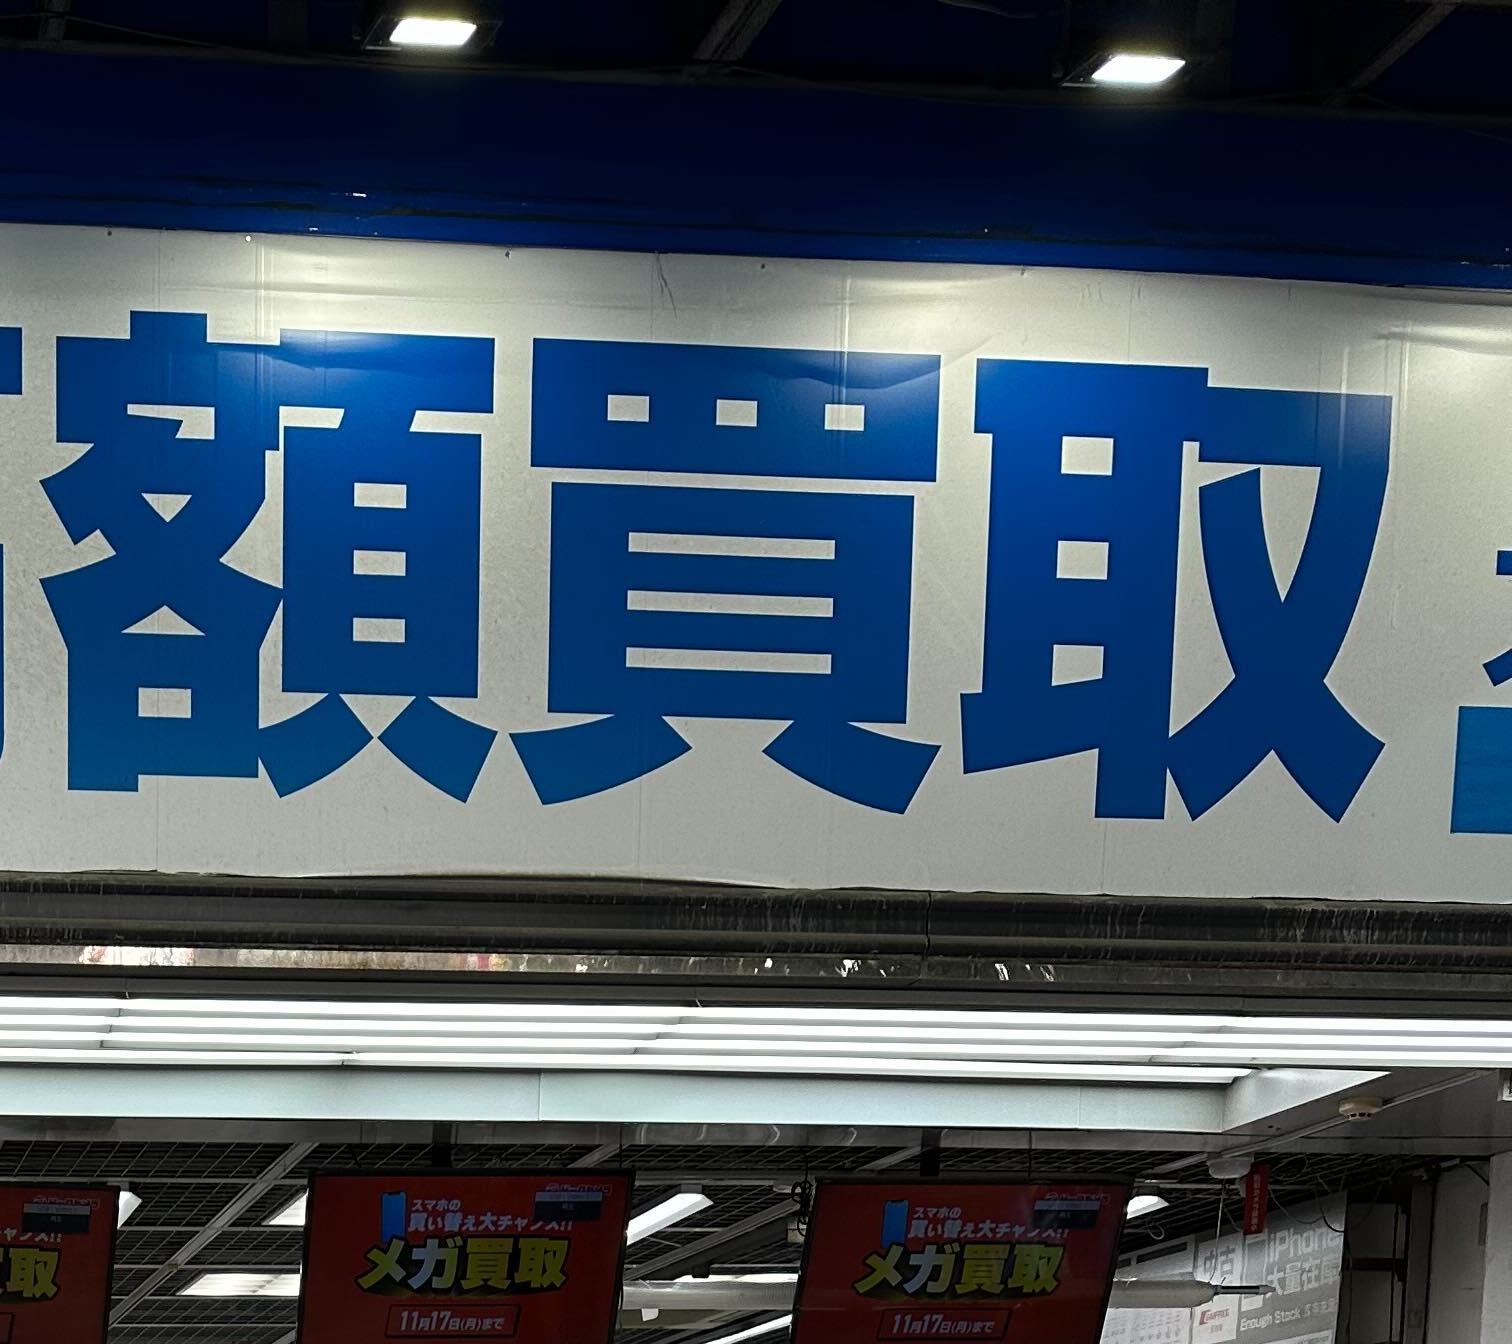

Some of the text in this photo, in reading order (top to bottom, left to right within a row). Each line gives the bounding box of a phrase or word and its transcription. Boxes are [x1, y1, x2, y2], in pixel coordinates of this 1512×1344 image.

[356, 1235, 569, 1290] メガ買取
[853, 1242, 1064, 1295] メガ買取
